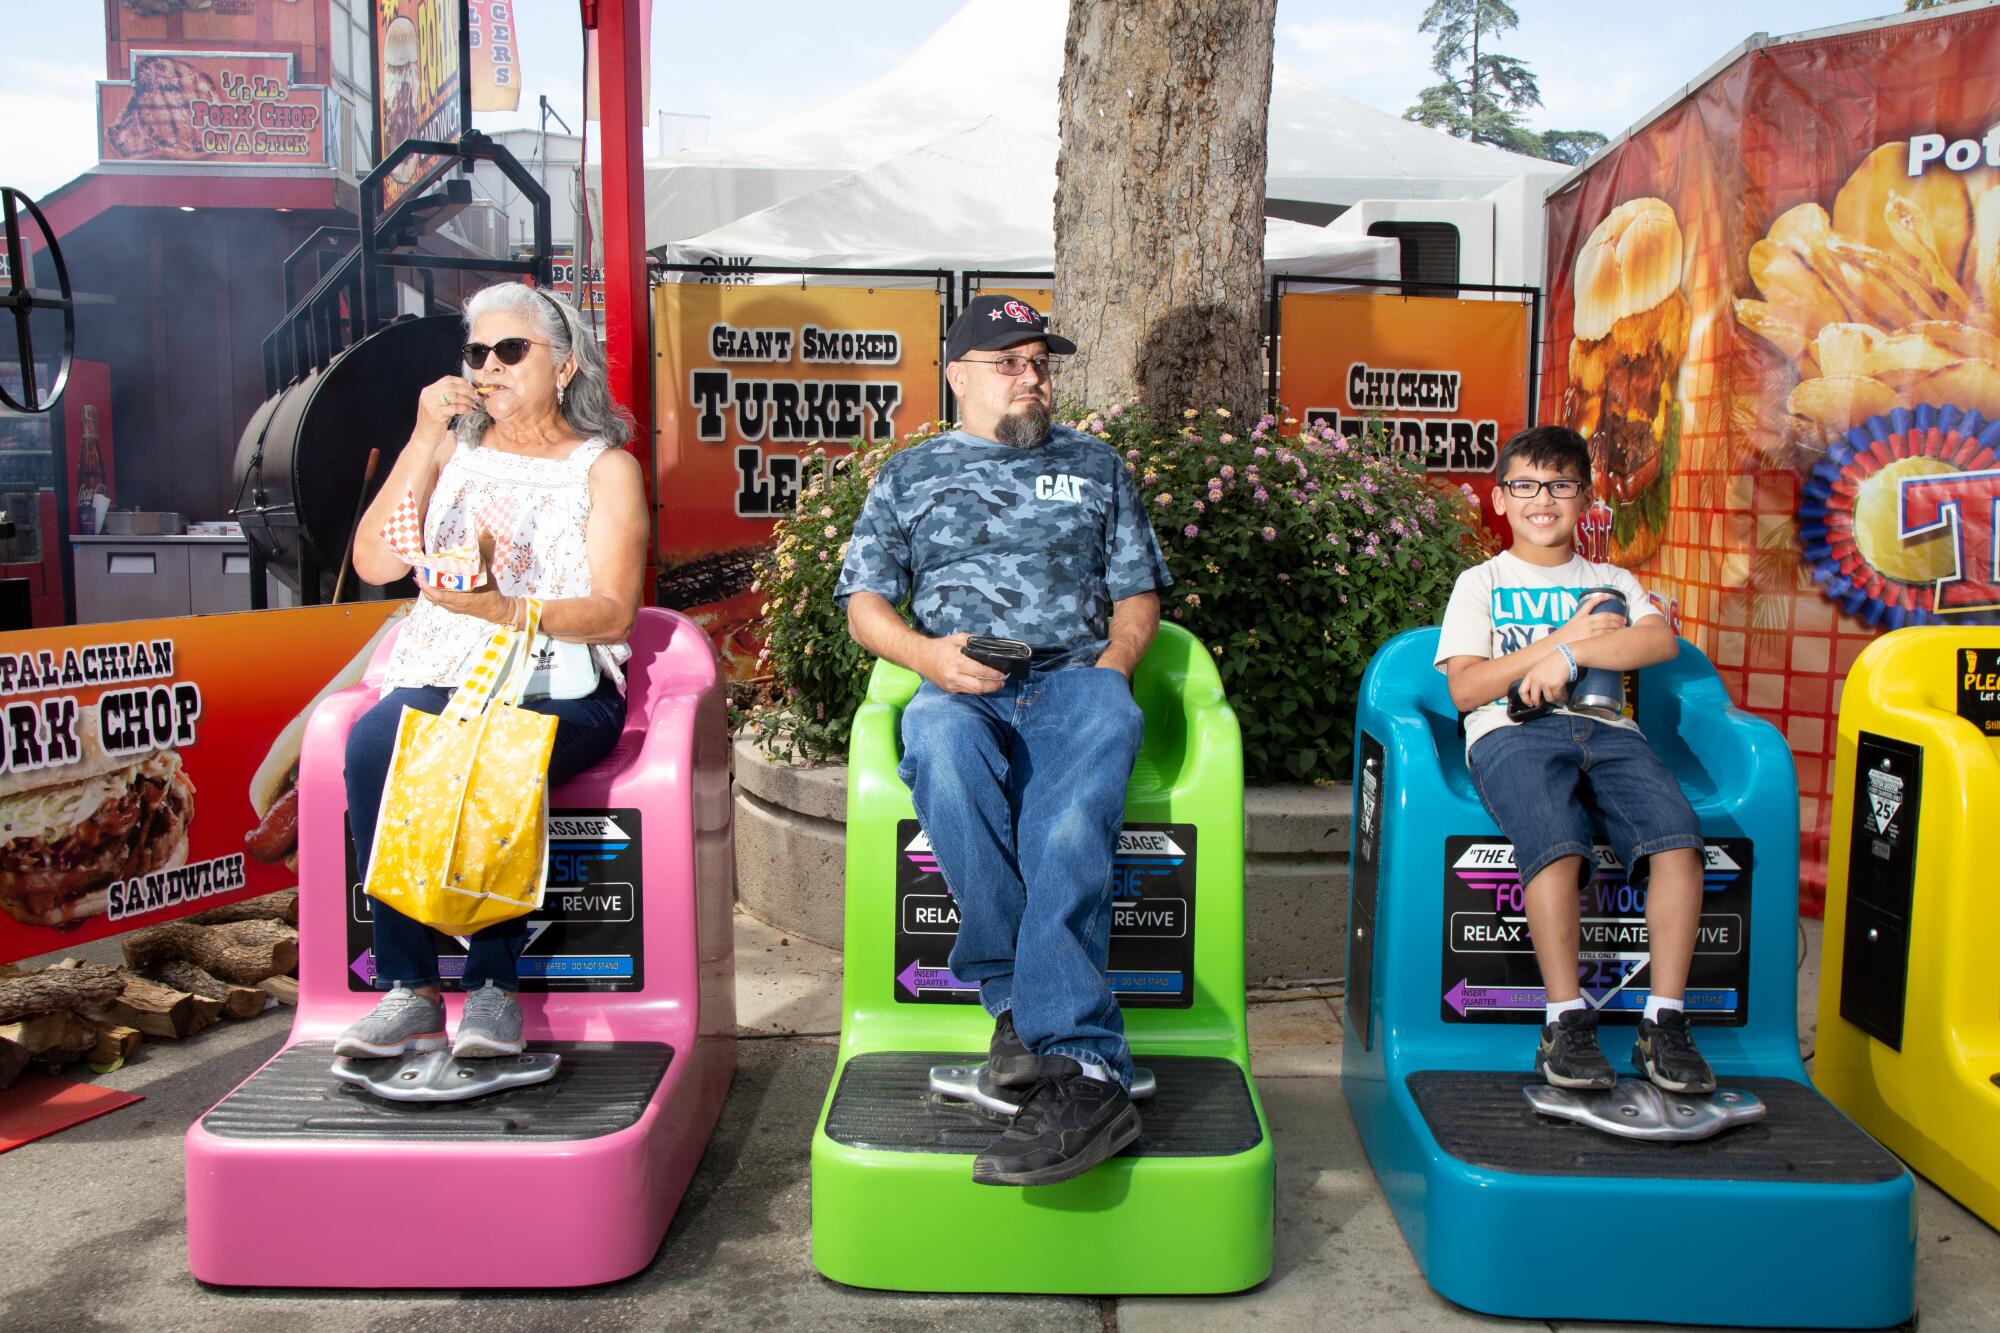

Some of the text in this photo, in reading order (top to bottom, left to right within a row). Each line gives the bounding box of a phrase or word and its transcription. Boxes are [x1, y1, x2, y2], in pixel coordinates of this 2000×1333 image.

[492, 4, 512, 84] GERS
[255, 77, 286, 99] LB.
[192, 102, 318, 129] PORK CHOP
[204, 131, 306, 153] ON A STICK
[1908, 133, 2000, 176] Pot
[712, 326, 898, 360] GIANT SMOKED
[1350, 365, 1458, 408] CHICKEN
[694, 372, 898, 439] TURKEY
[1036, 474, 1088, 503] CAT
[1496, 626, 1535, 655] MY
[1, 641, 172, 692] PALACHIAN
[1981, 691, 1994, 701] Let
[0, 685, 198, 768] RK CHOP
[549, 821, 610, 836] ASSAGE"
[1116, 835, 1165, 850] SAGE"
[109, 854, 244, 918] SANDWICH
[563, 896, 622, 911] REVIVE
[916, 908, 1174, 926] RELA REVIVE
[1464, 926, 1520, 942] RELAX
[1581, 926, 1648, 943] VENATE
[914, 979, 949, 987] QUARTER
[915, 970, 938, 978] INSERT
[1461, 998, 1496, 1006] QUARTER
